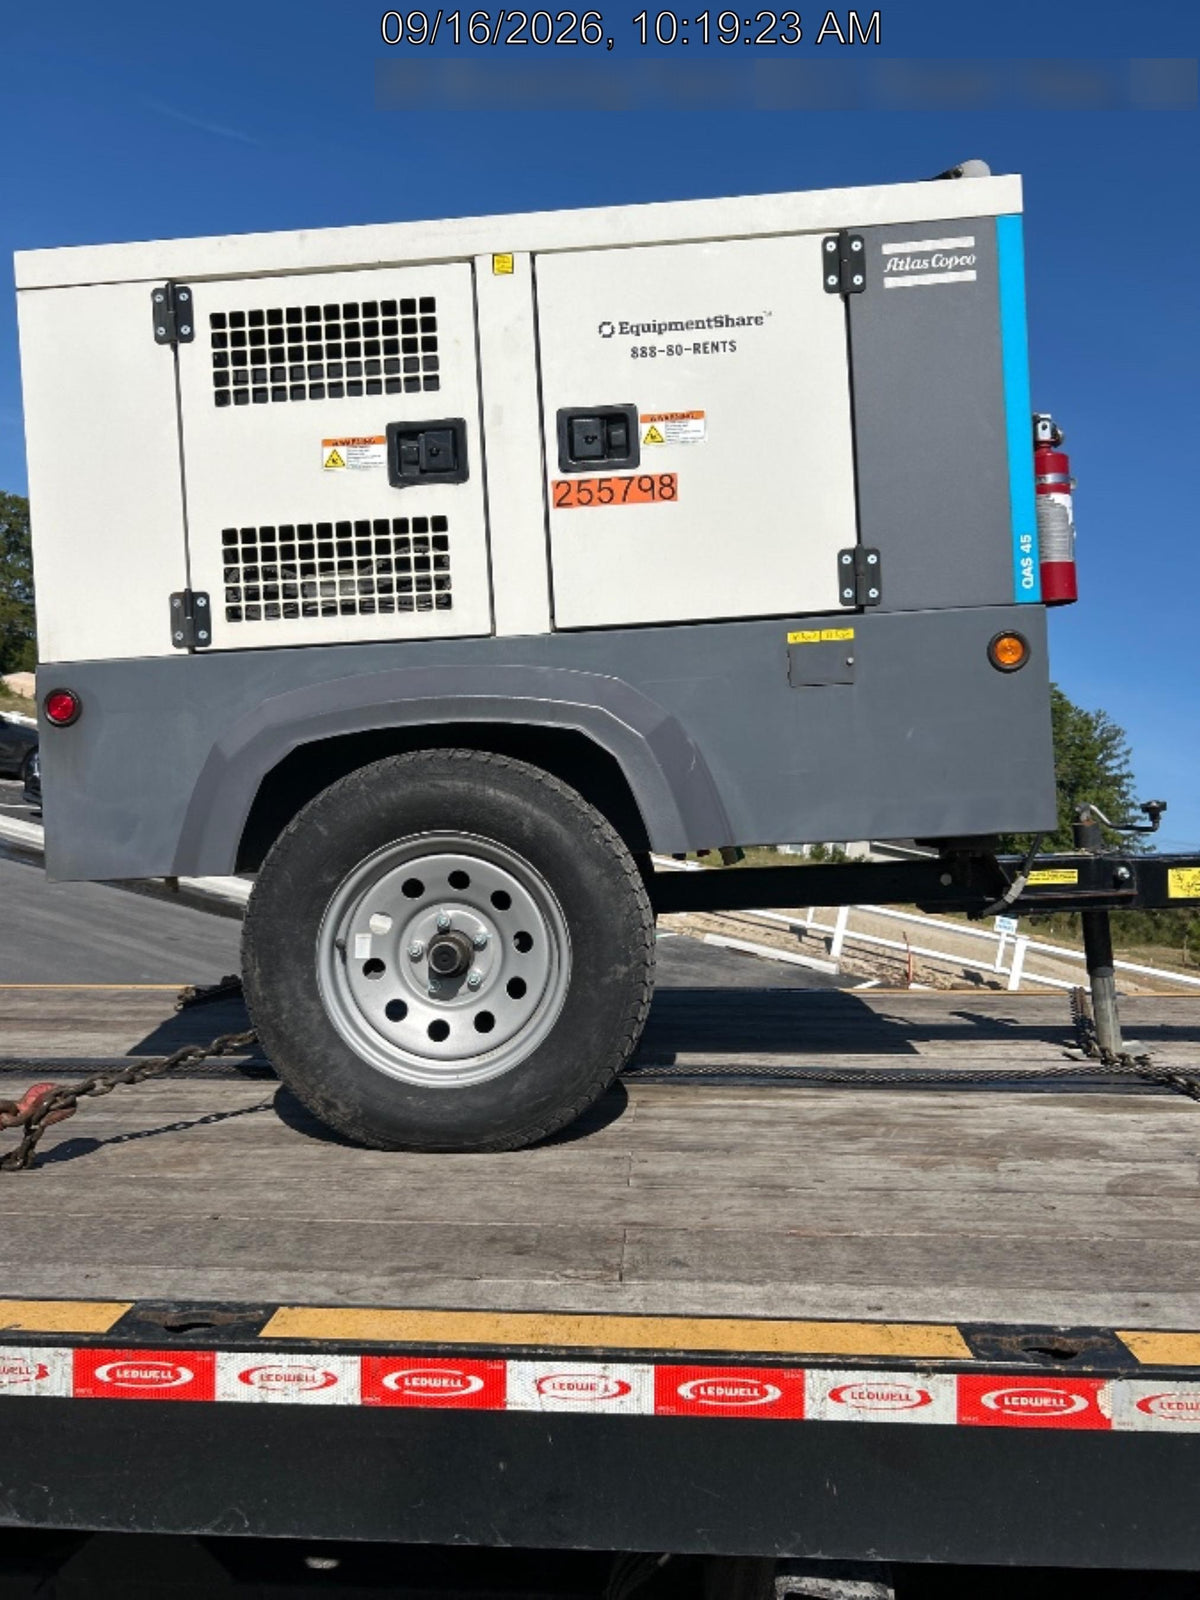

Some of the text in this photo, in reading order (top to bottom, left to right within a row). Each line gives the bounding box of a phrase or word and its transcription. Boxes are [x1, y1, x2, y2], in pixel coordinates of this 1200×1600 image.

[884, 253, 976, 272] Atlas Copco
[618, 314, 764, 335] EquipmentShare
[630, 340, 737, 359] 888-80-RENTS
[555, 473, 676, 507] 255798
[1020, 534, 1034, 588] QAS 45
[116, 1369, 174, 1381] LEDWELL
[260, 1373, 317, 1384] LEDWELL
[404, 1377, 463, 1388] LEDWELL
[700, 1386, 760, 1397] LEDWELL
[850, 1391, 912, 1402] LEDWELL
[1003, 1396, 1067, 1408] LEDWELL
